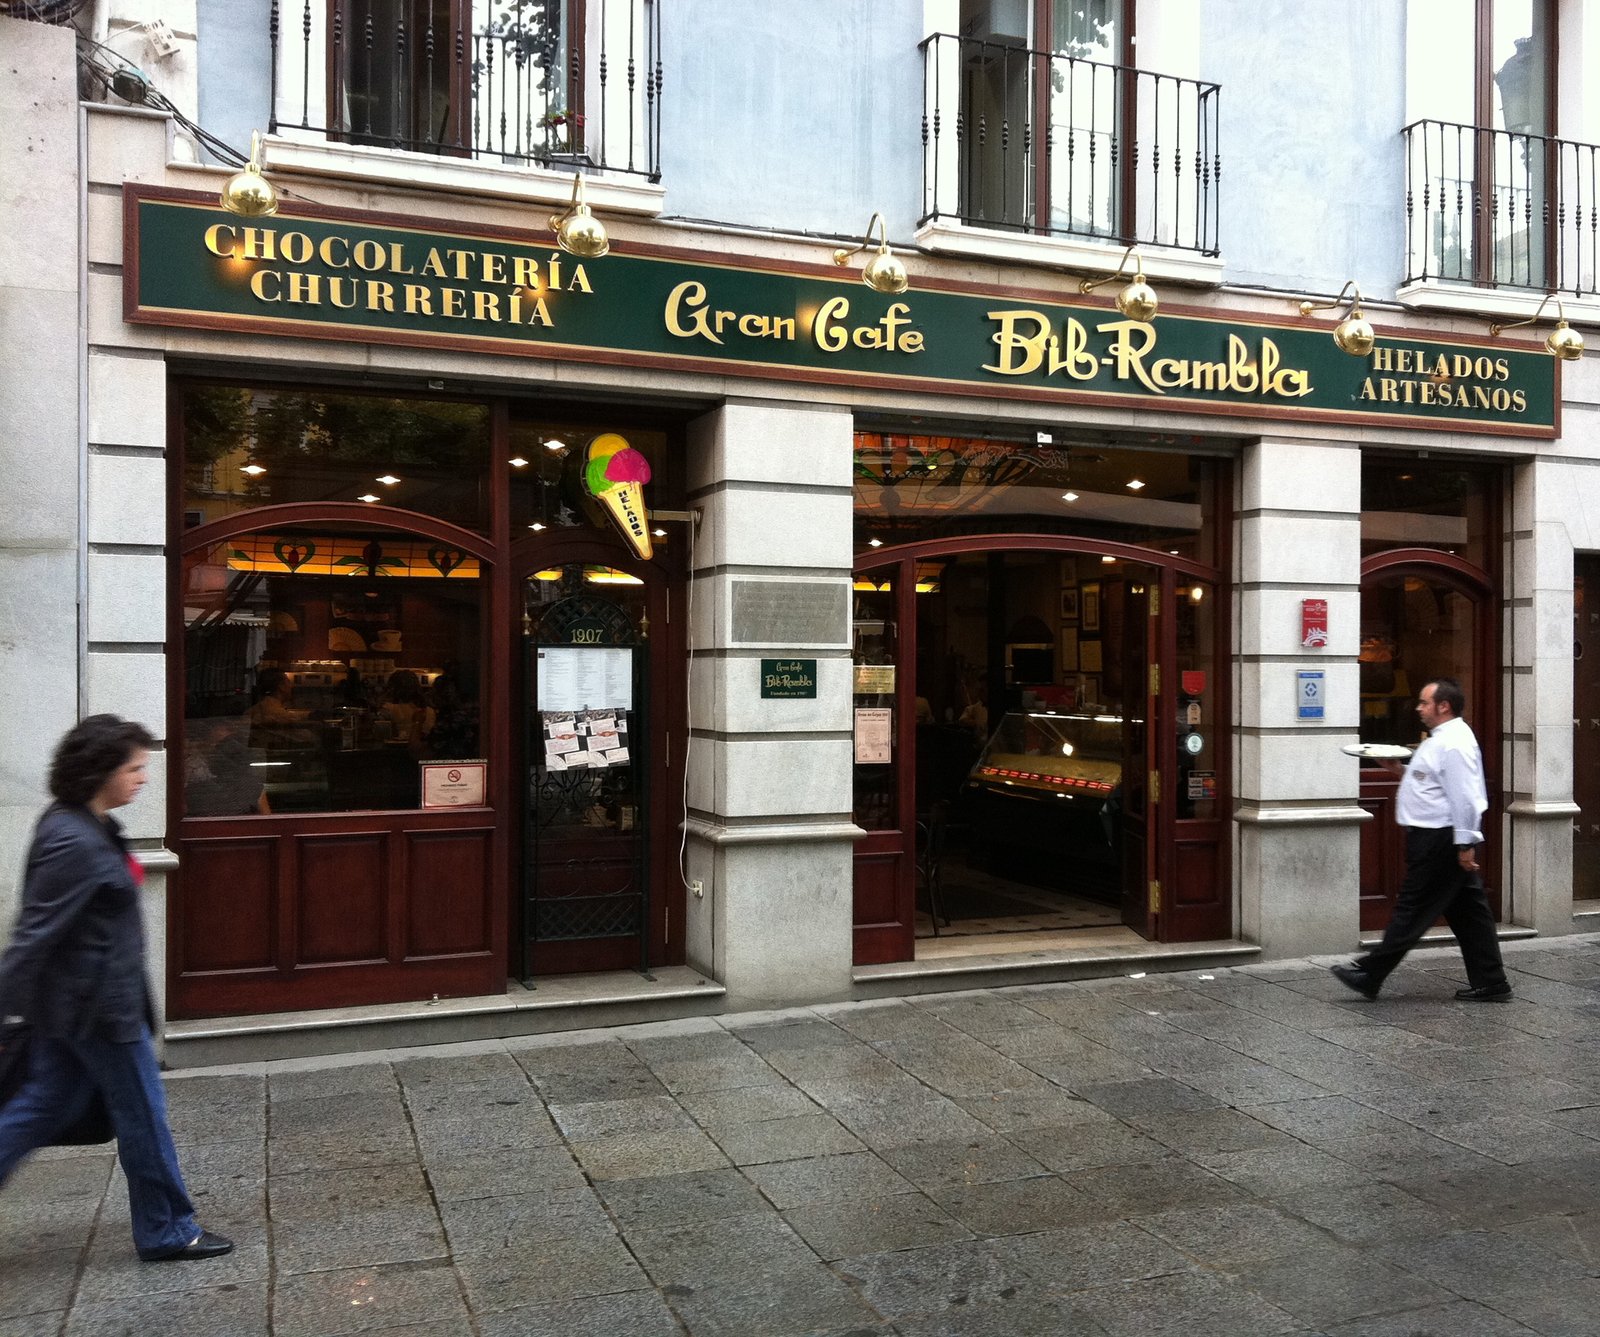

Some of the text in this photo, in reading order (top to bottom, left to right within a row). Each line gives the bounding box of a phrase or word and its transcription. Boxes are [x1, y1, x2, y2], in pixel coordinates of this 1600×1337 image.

[204, 223, 594, 293] CHOCOLATERÍA
[250, 269, 555, 327] CHURRERÍA
[664, 280, 795, 345] Gran
[980, 309, 1314, 398] Bib-Rambla
[1372, 347, 1509, 382] HELADOS
[1360, 376, 1527, 413] ARTESANOS
[618, 490, 643, 537] HELADOS
[570, 628, 604, 644] 1907
